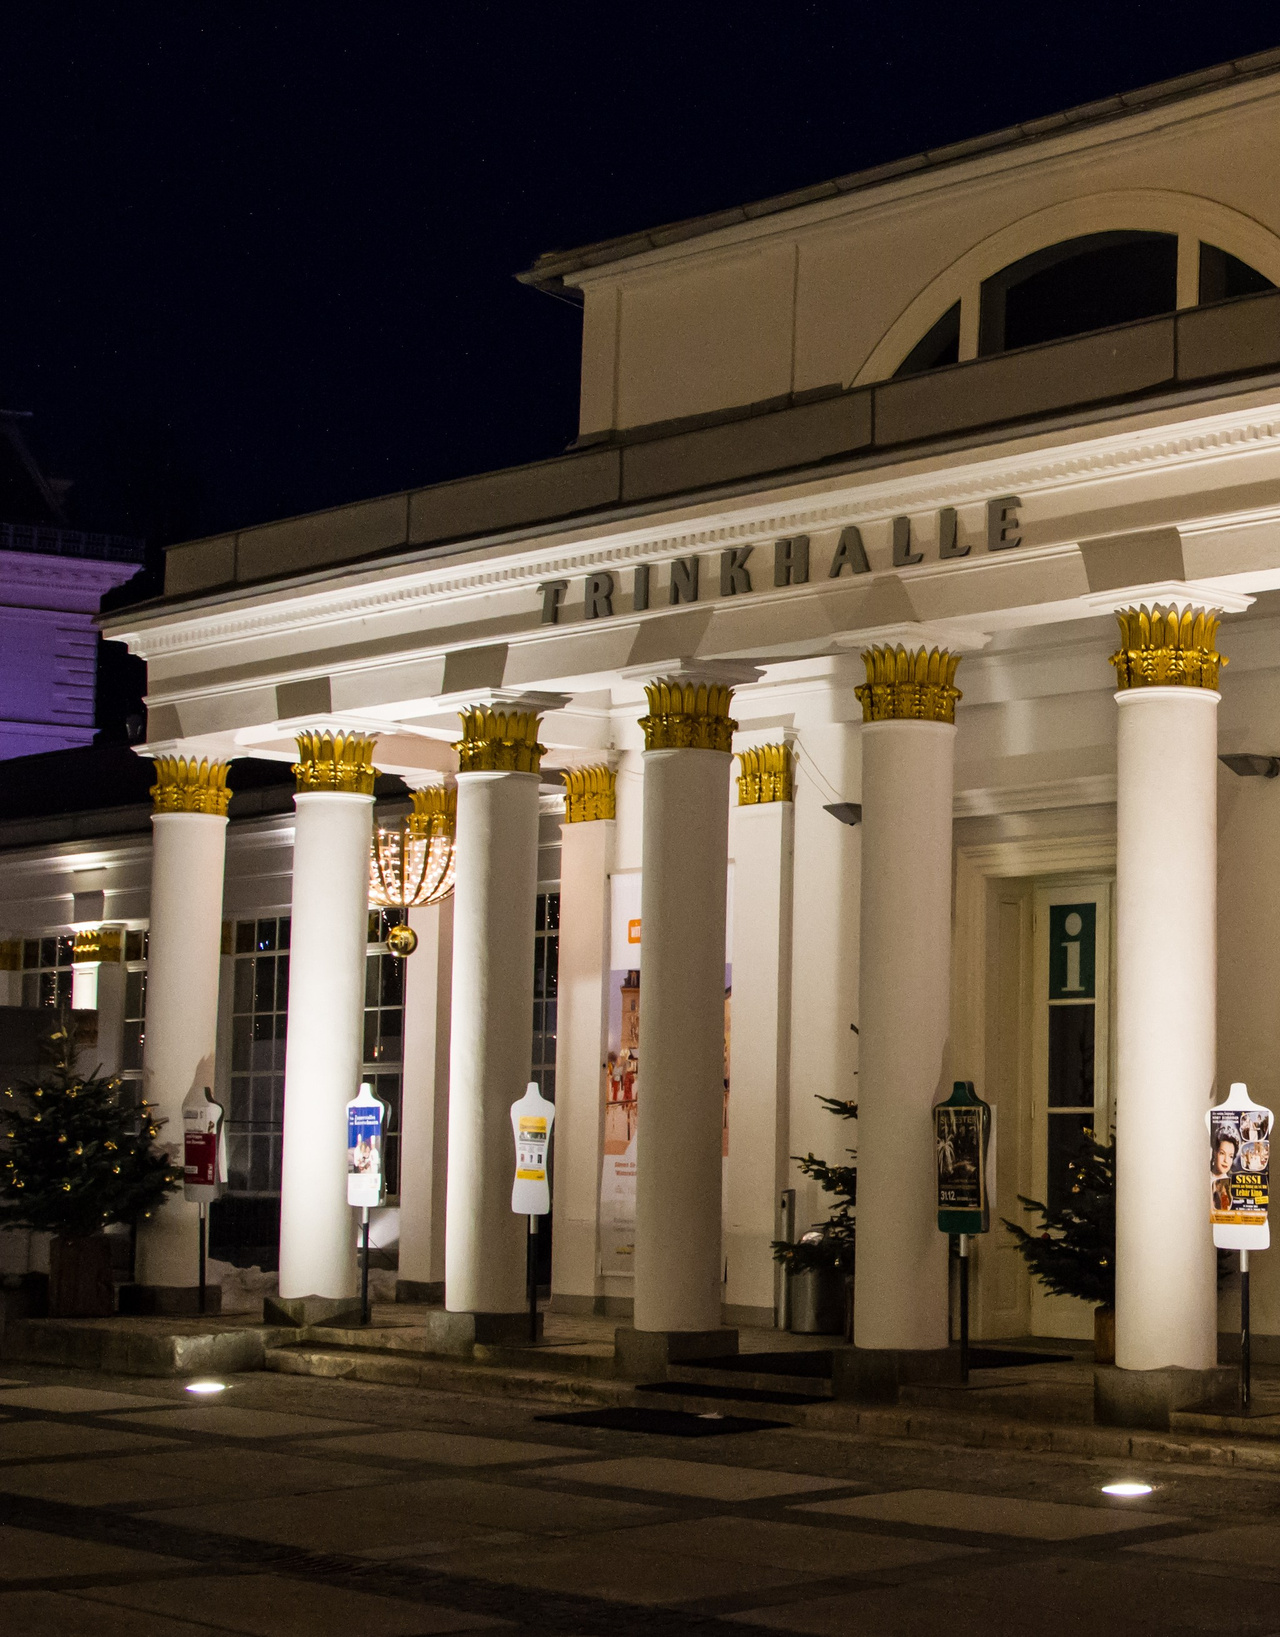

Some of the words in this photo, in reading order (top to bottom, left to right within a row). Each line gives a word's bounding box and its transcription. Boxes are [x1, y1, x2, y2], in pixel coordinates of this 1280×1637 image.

[537, 496, 1024, 625] TRINKHALLE
[1061, 912, 1086, 992] i
[1236, 1175, 1261, 1184] SISSI
